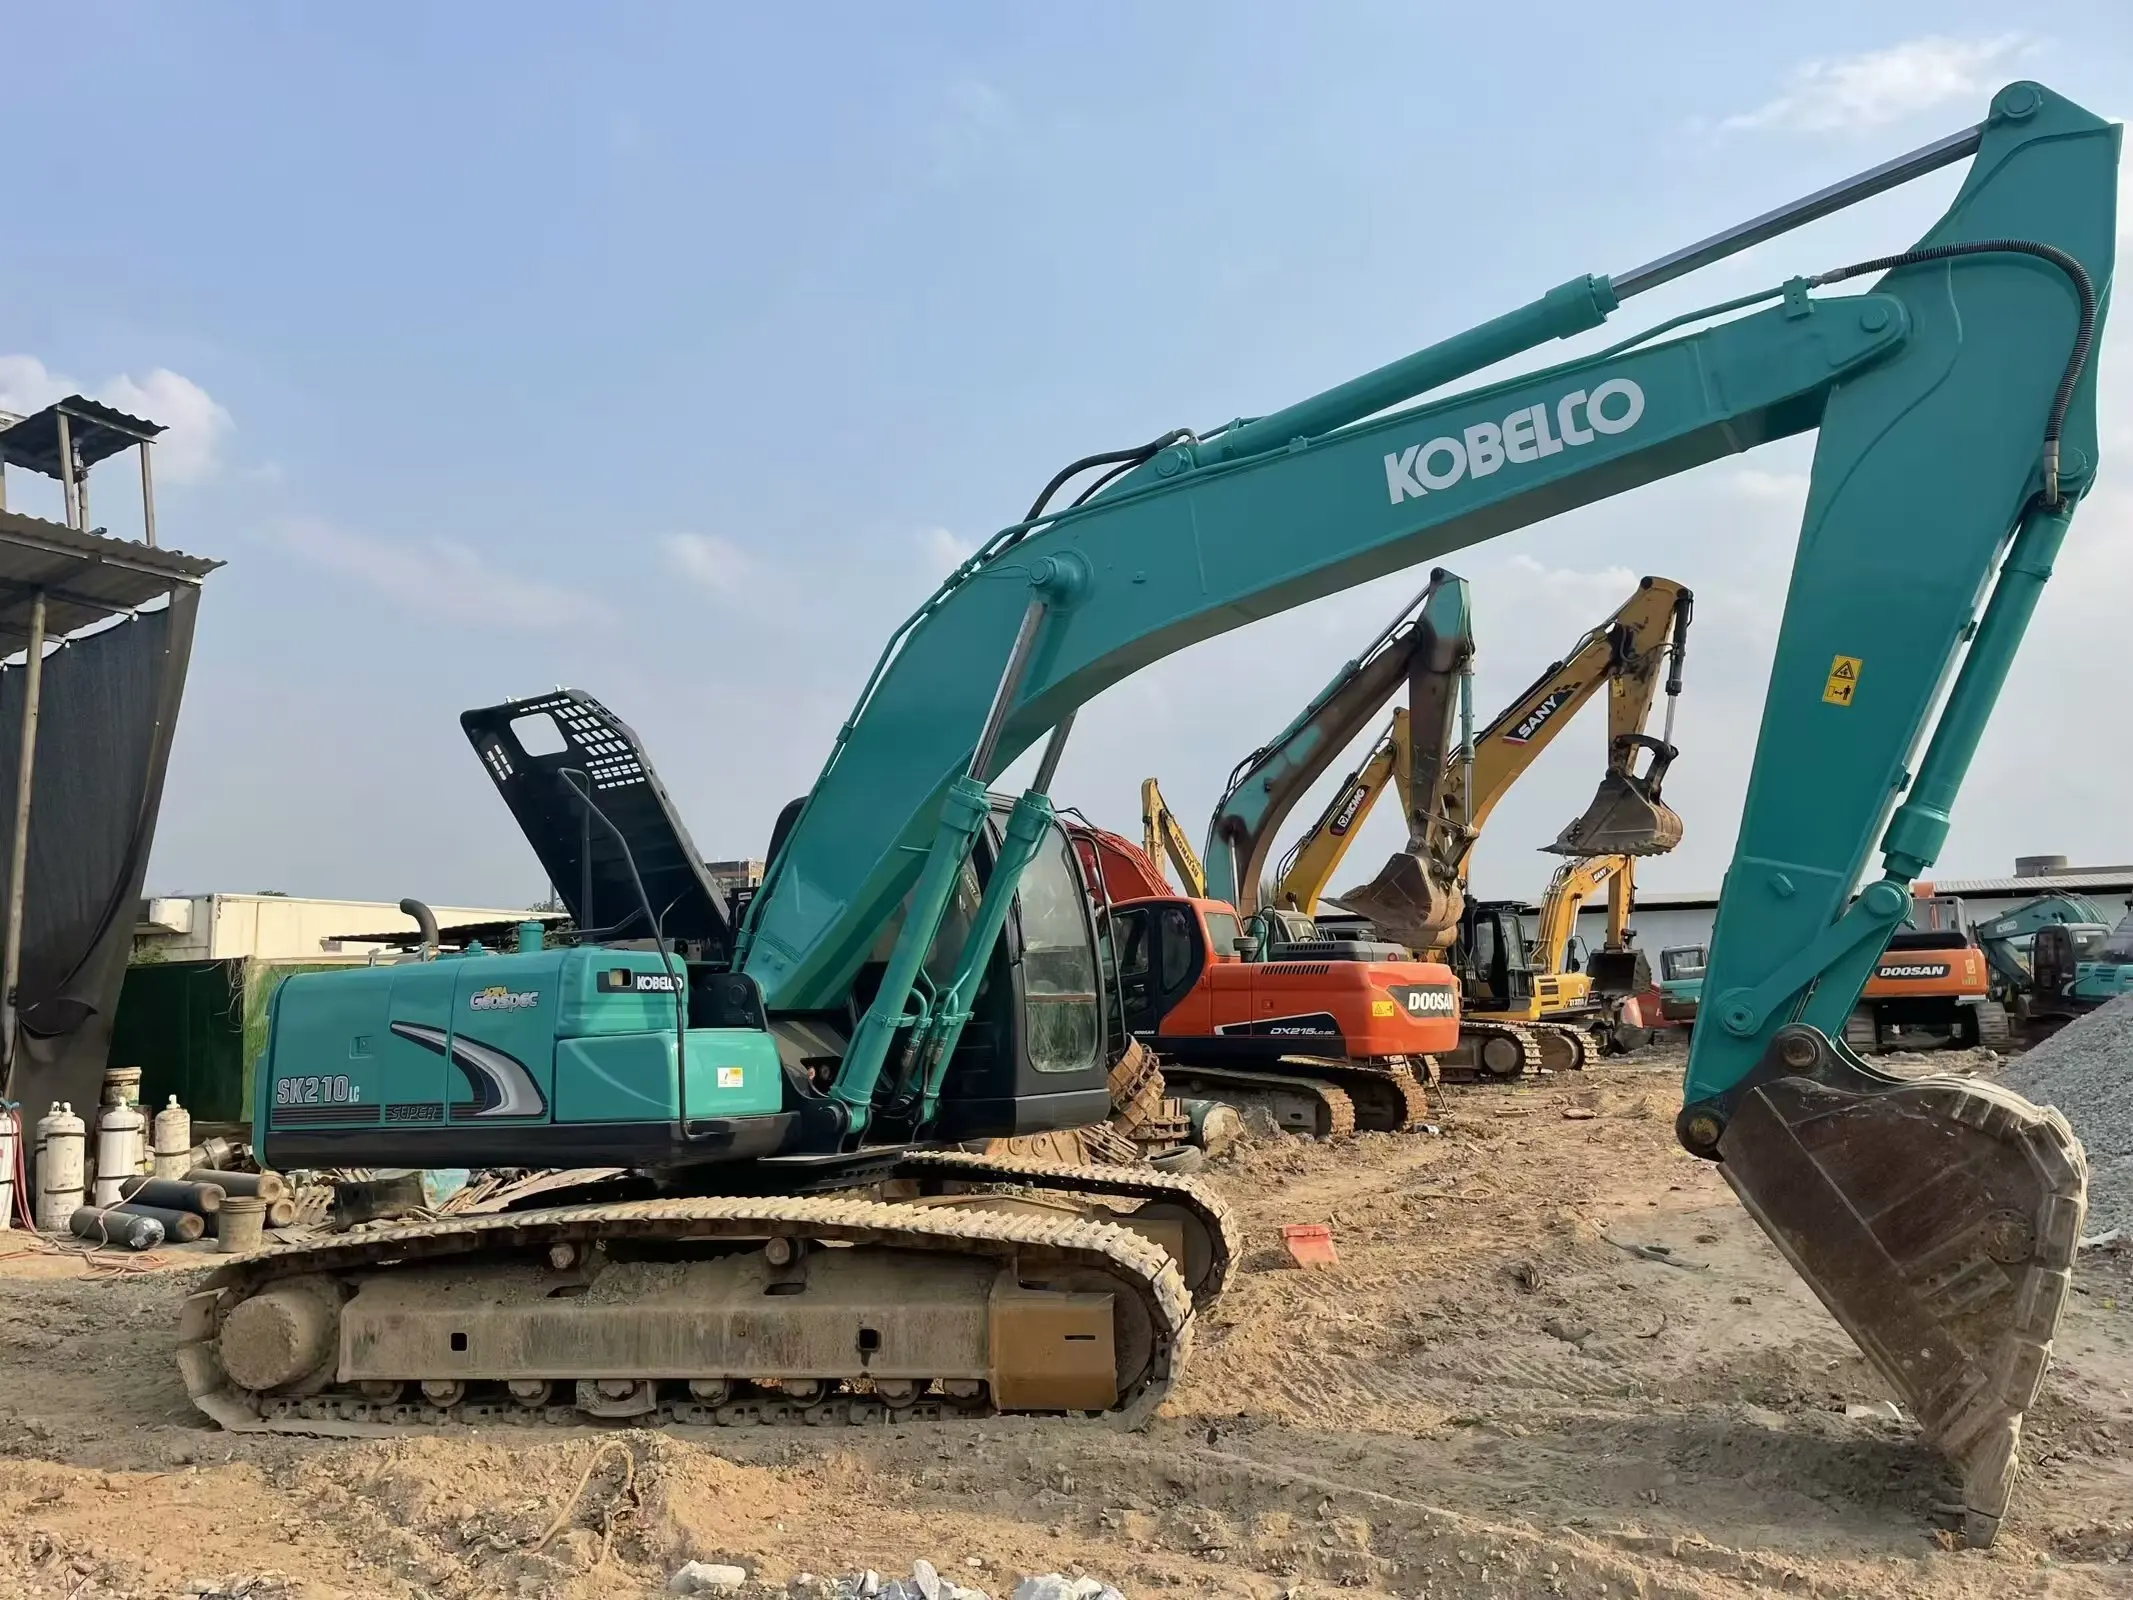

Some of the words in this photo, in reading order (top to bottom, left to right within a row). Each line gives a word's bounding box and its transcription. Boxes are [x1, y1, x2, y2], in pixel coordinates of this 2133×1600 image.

[1384, 378, 1645, 505] KOBELCO
[1518, 694, 1557, 738] SANY
[1343, 788, 1365, 819] XCMG
[1880, 965, 1944, 977] DOOSAN
[1408, 991, 1454, 1011] DOOSAN
[390, 1105, 437, 1121] SUPER
